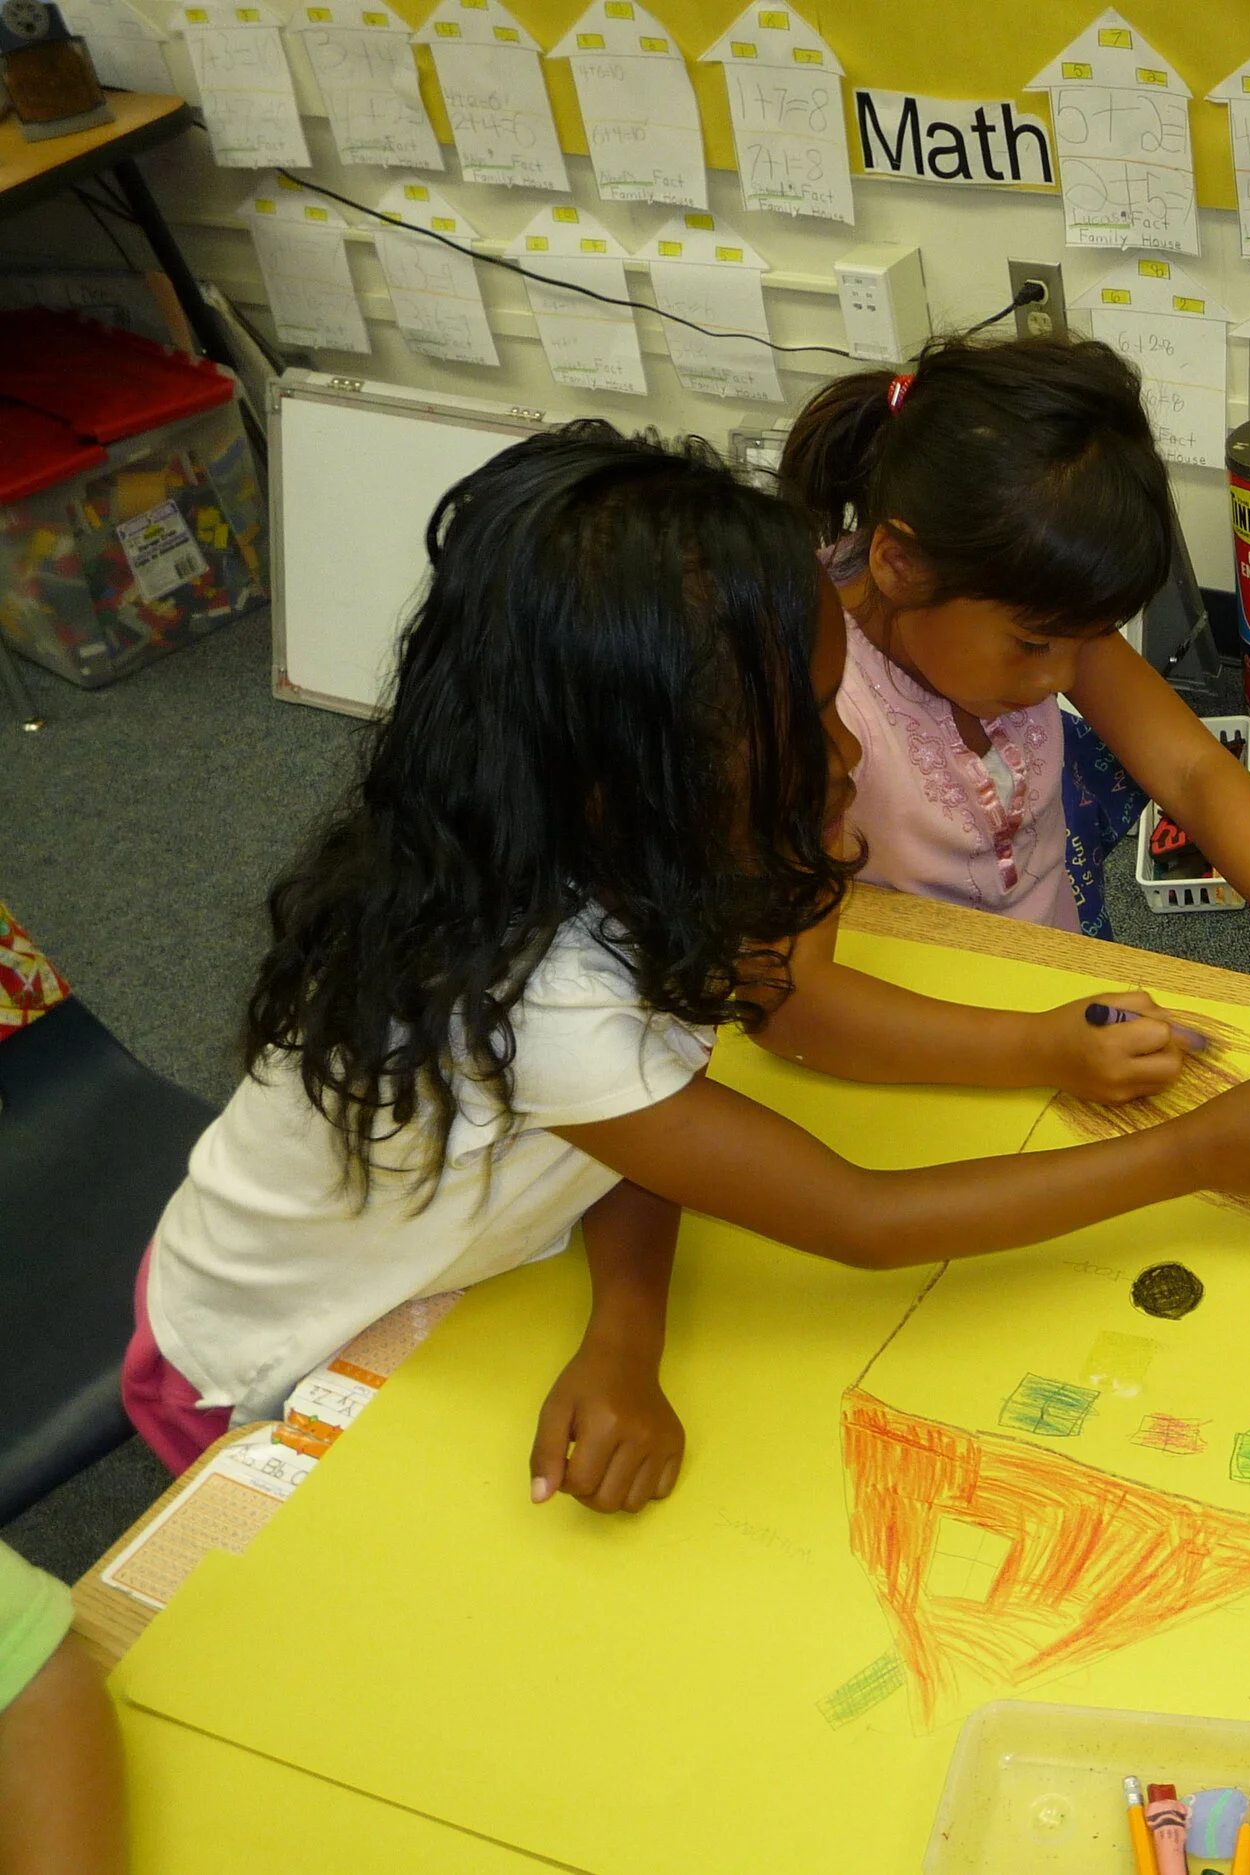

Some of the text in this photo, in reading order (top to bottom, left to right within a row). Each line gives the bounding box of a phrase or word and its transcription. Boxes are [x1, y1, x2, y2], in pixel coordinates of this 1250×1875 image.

[1111, 31, 1123, 45] 7
[1072, 64, 1084, 78] 5
[737, 76, 830, 133] 1+7=8
[592, 127, 646, 146] 6+4=10
[855, 91, 1053, 183] Math
[512, 154, 543, 173] Fact
[746, 143, 825, 182] 7+1=8
[473, 171, 555, 190] Family House
[653, 169, 685, 188] Fact
[611, 188, 697, 208] Family House
[801, 184, 835, 204] Fact
[758, 198, 845, 222] Family House
[1132, 210, 1170, 231] Fact
[1079, 228, 1182, 250] Family House
[1179, 298, 1189, 310] 2
[595, 357, 623, 375] Fact
[1158, 426, 1197, 447] Fact
[1168, 450, 1206, 466] House
[1072, 835, 1094, 886] is fun
[261, 1456, 285, 1480] Bb
